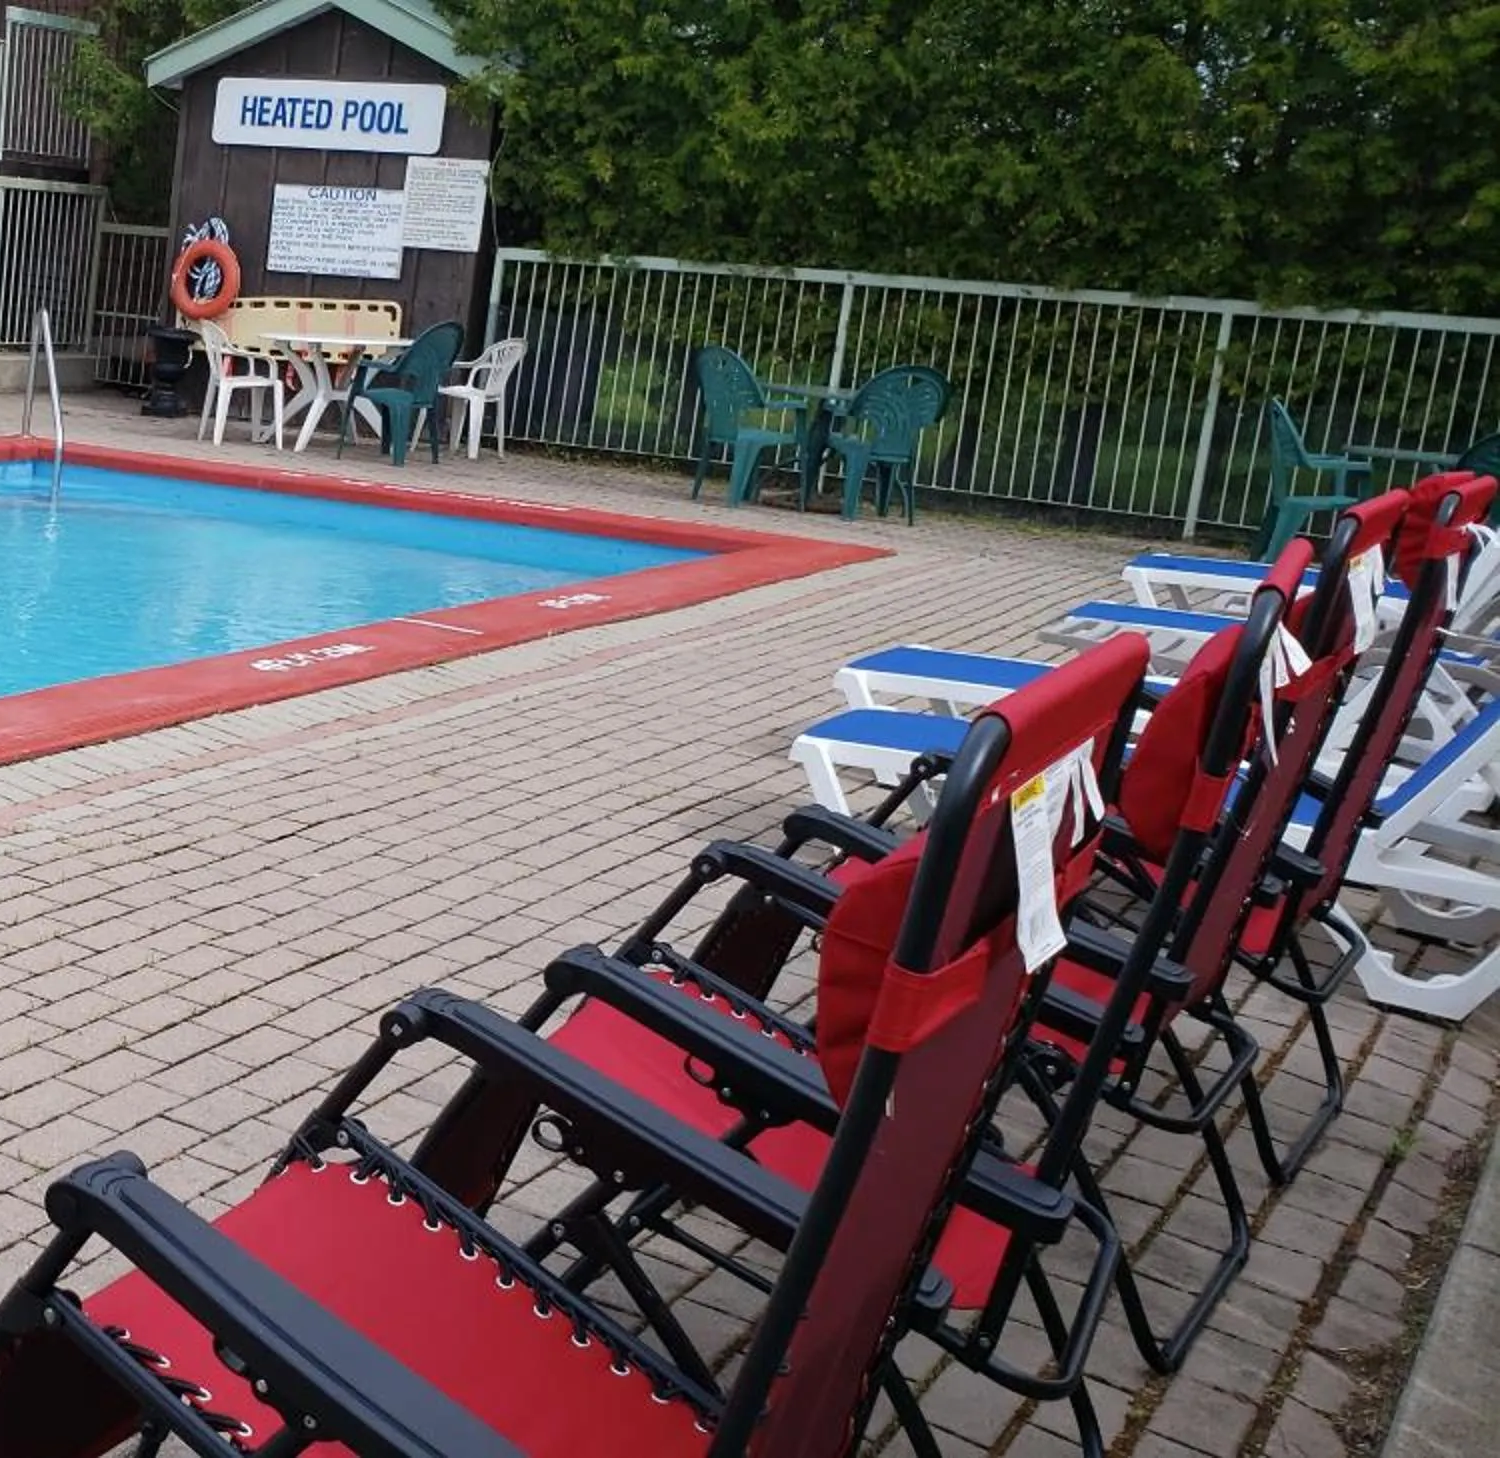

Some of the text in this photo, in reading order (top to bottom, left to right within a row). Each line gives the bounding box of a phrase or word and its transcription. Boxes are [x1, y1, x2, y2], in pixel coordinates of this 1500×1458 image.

[241, 95, 409, 134] HEATED POOL
[308, 187, 377, 201] CAUTION
